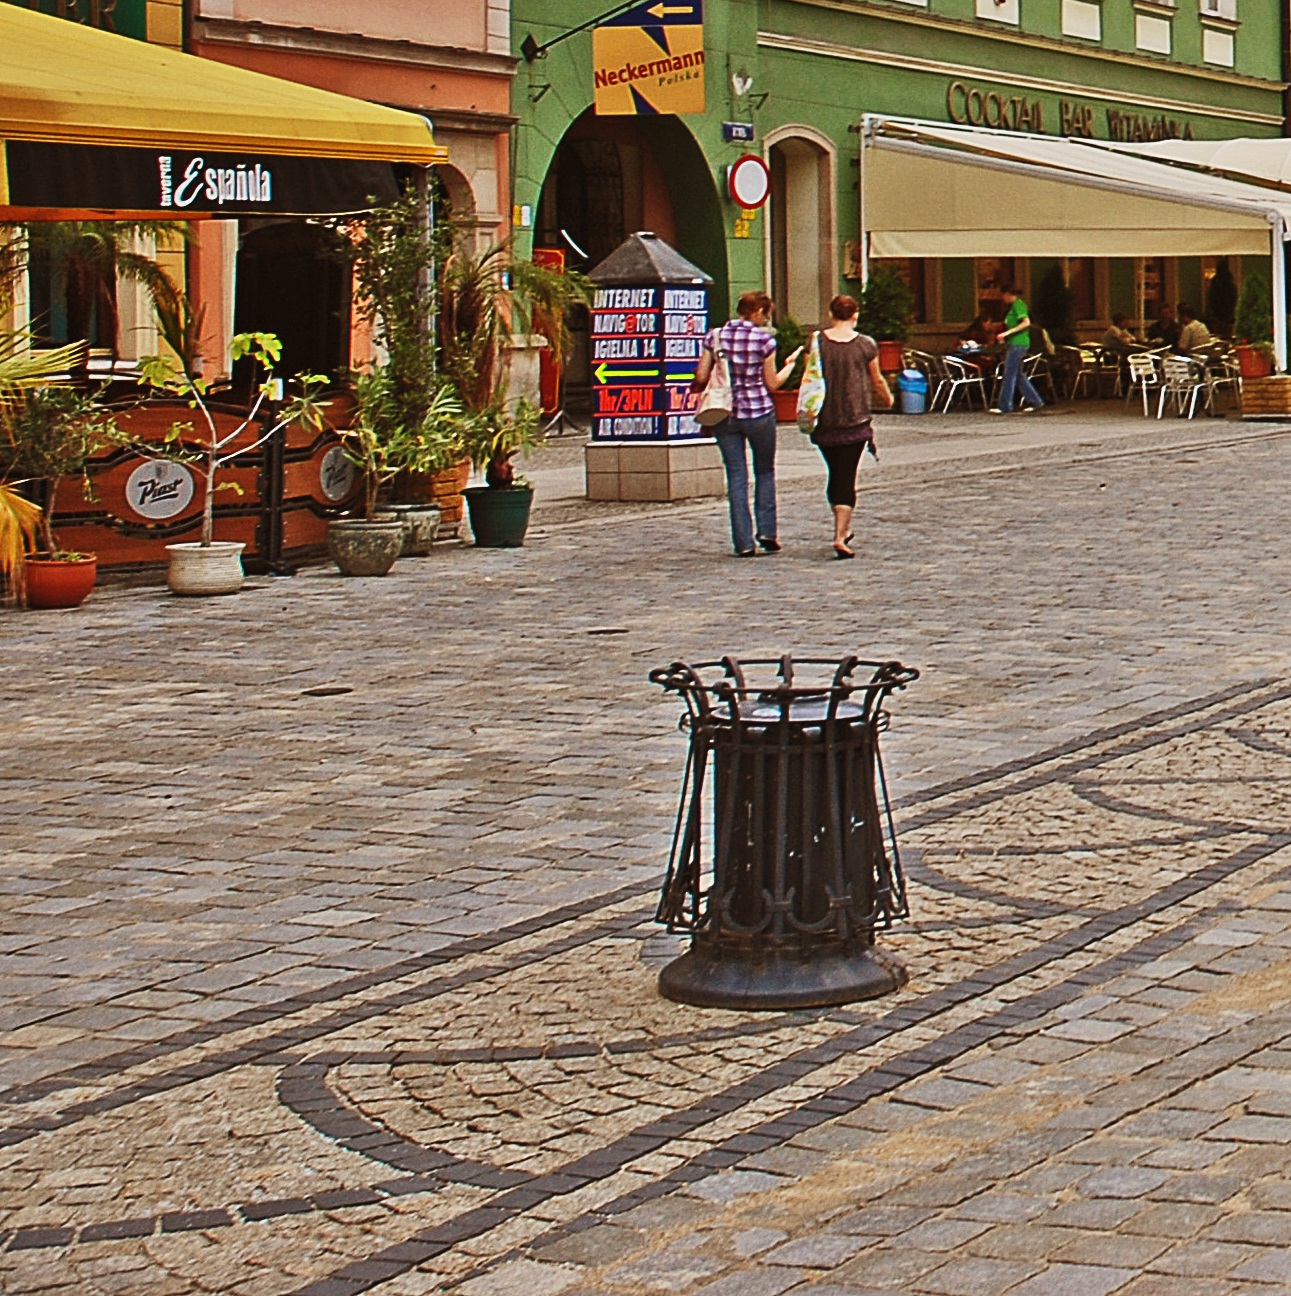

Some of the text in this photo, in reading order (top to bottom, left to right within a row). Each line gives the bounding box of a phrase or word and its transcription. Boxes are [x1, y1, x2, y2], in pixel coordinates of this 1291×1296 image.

[594, 50, 706, 89] Neckermann
[658, 70, 701, 88] Polska
[1059, 99, 1096, 139] BAR
[593, 289, 655, 309] INTERNET
[663, 290, 706, 310] INTERNET
[593, 313, 656, 334] NAVIG@TOR
[594, 338, 657, 359] IGIELNA 14
